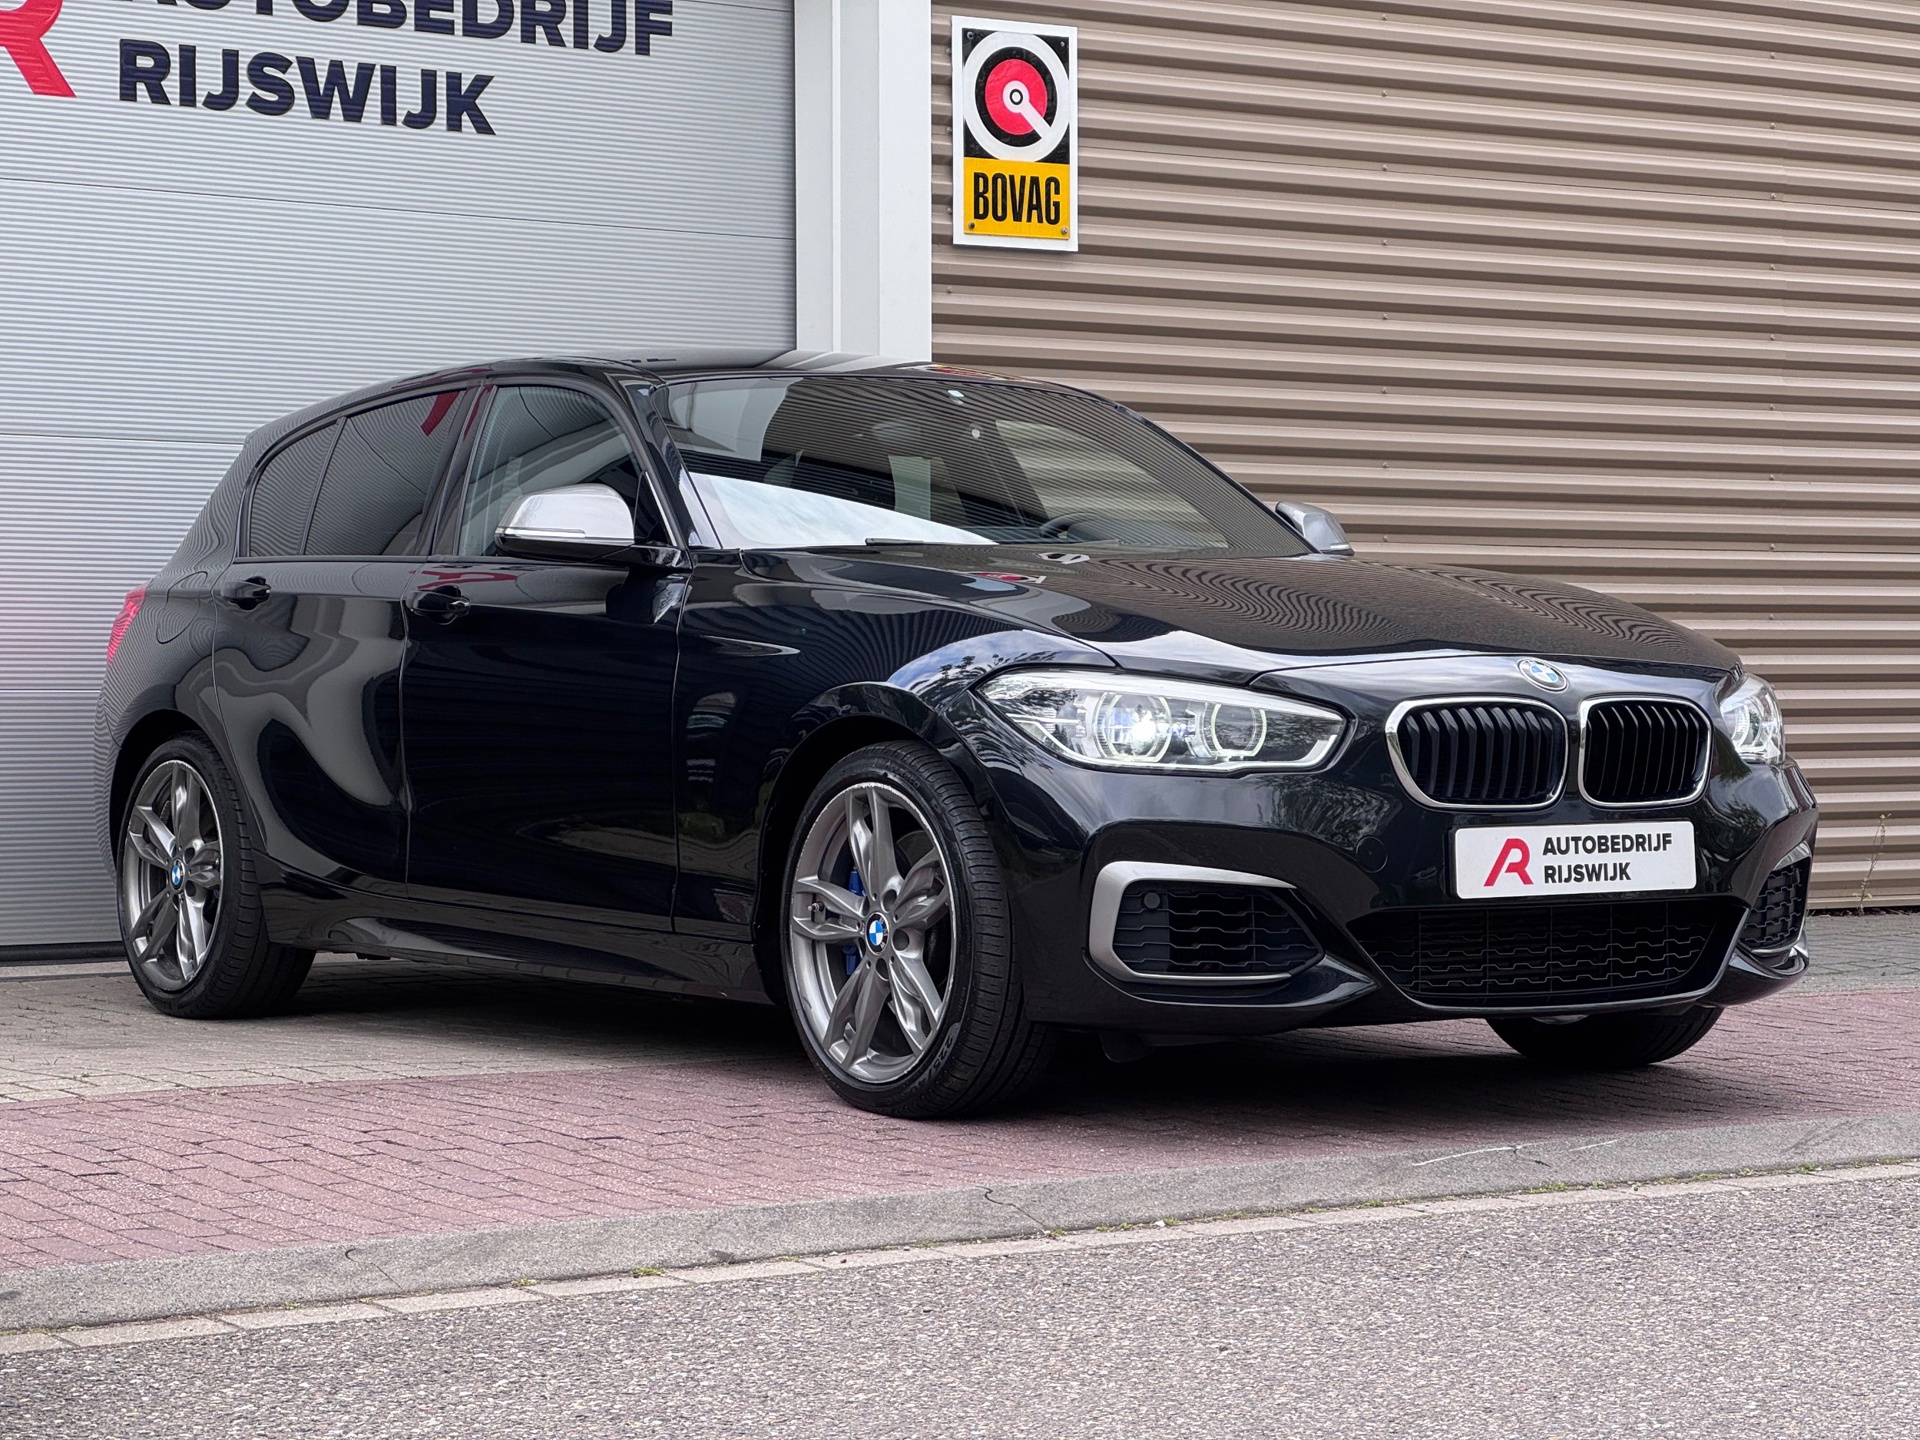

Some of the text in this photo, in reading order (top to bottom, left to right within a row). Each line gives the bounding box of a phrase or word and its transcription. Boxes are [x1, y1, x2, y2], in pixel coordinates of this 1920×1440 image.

[118, 0, 673, 56] EDRIJF
[119, 38, 497, 135] RIJSWIJK
[973, 171, 1060, 225] BOVAG
[1542, 833, 1672, 855] AUTOBEDRIJF
[1544, 862, 1631, 884] RIJSWIJK
